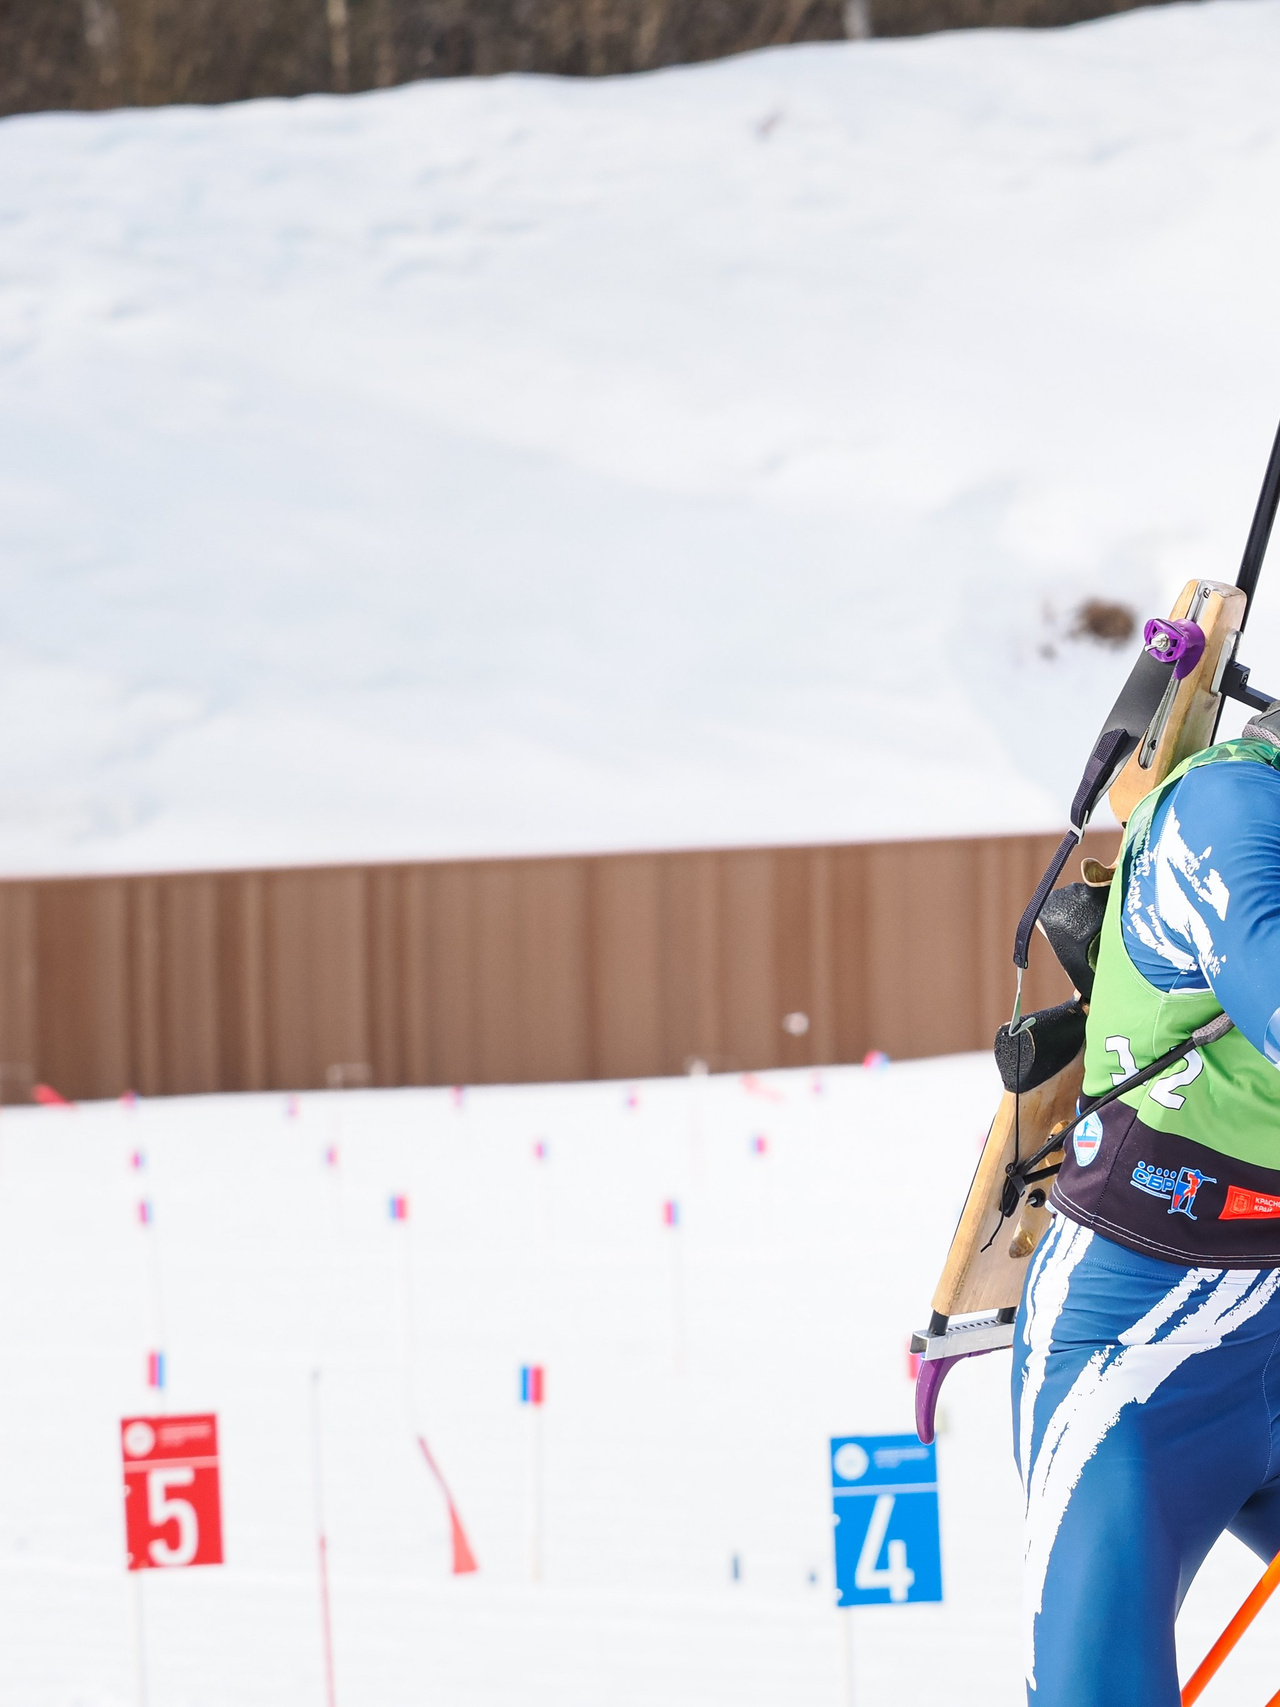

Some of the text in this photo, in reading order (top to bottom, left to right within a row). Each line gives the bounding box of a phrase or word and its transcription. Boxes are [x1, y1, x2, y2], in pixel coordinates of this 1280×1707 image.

[1132, 1167, 1175, 1192] СБР
[1254, 1204, 1273, 1212] КРАЙ
[147, 1467, 199, 1567] 5
[855, 1493, 915, 1603] 4
